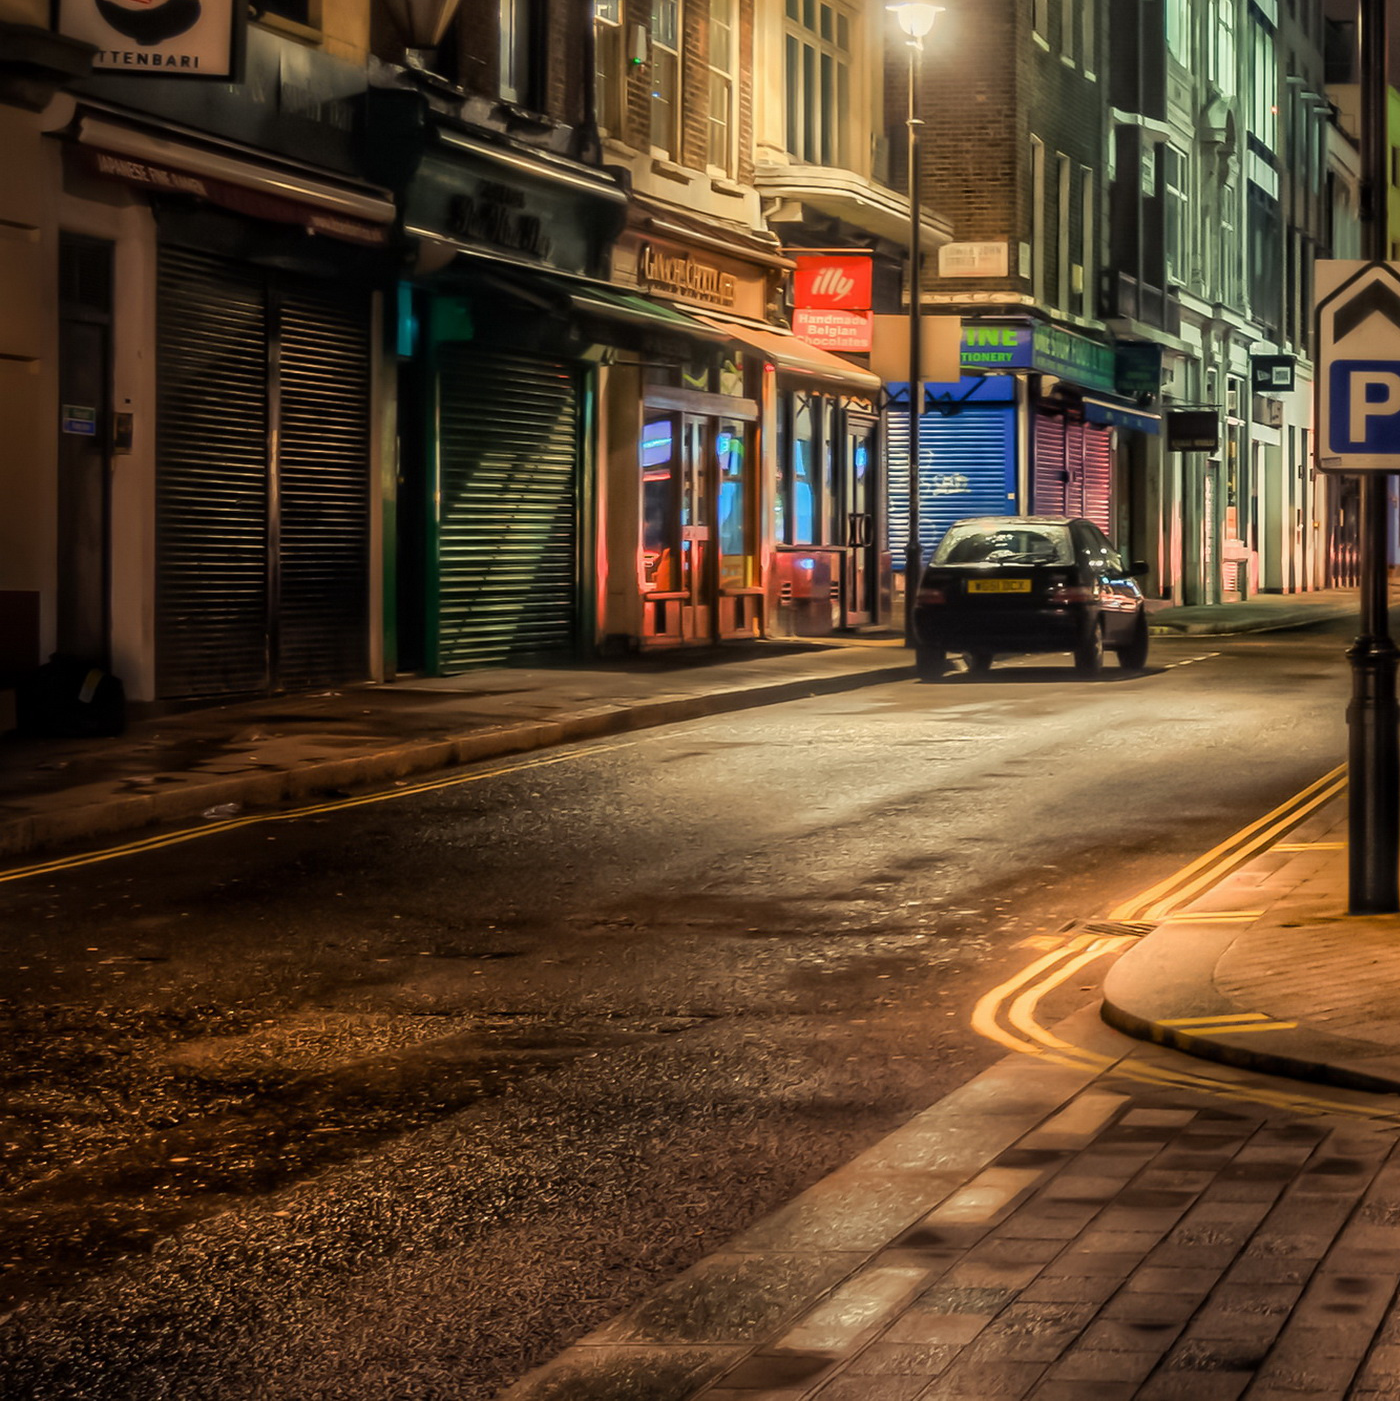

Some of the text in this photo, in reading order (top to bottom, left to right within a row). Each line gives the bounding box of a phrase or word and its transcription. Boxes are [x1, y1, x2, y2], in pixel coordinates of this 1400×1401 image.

[98, 50, 199, 69] TTENBARI
[810, 267, 855, 303] illy
[798, 313, 868, 326] Handmade
[807, 325, 858, 337] Belgian
[966, 327, 1019, 347] INE
[960, 352, 1014, 363] TIONERY
